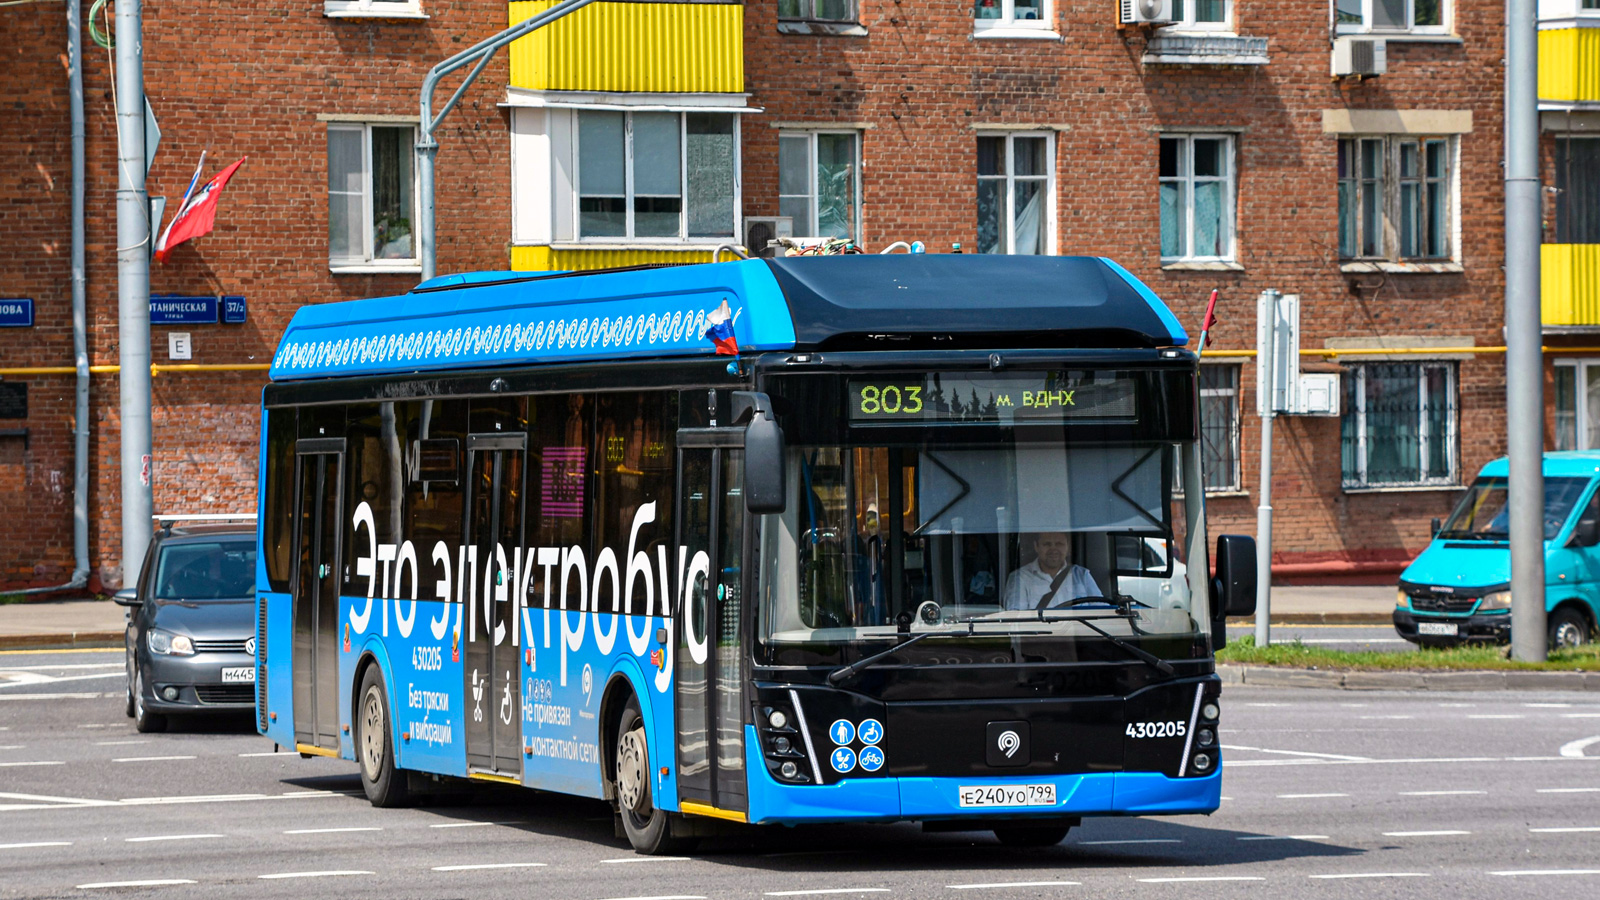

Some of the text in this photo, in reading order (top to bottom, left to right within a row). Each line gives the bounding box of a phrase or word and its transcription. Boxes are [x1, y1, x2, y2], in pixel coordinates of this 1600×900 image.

[0, 304, 23, 314] ОВА
[227, 302, 244, 313] 37/2
[860, 385, 923, 414] 803
[996, 390, 1075, 408] м. ВДНХ
[349, 500, 709, 693] Это электробус
[412, 646, 442, 671] 430205
[408, 683, 449, 715] Без тряски
[522, 695, 571, 729] Не привязан
[409, 715, 452, 747] и вибраций
[1125, 721, 1186, 738] 430205
[531, 735, 579, 760] контактной
[579, 742, 599, 764] сети
[1028, 786, 1052, 799] 799
